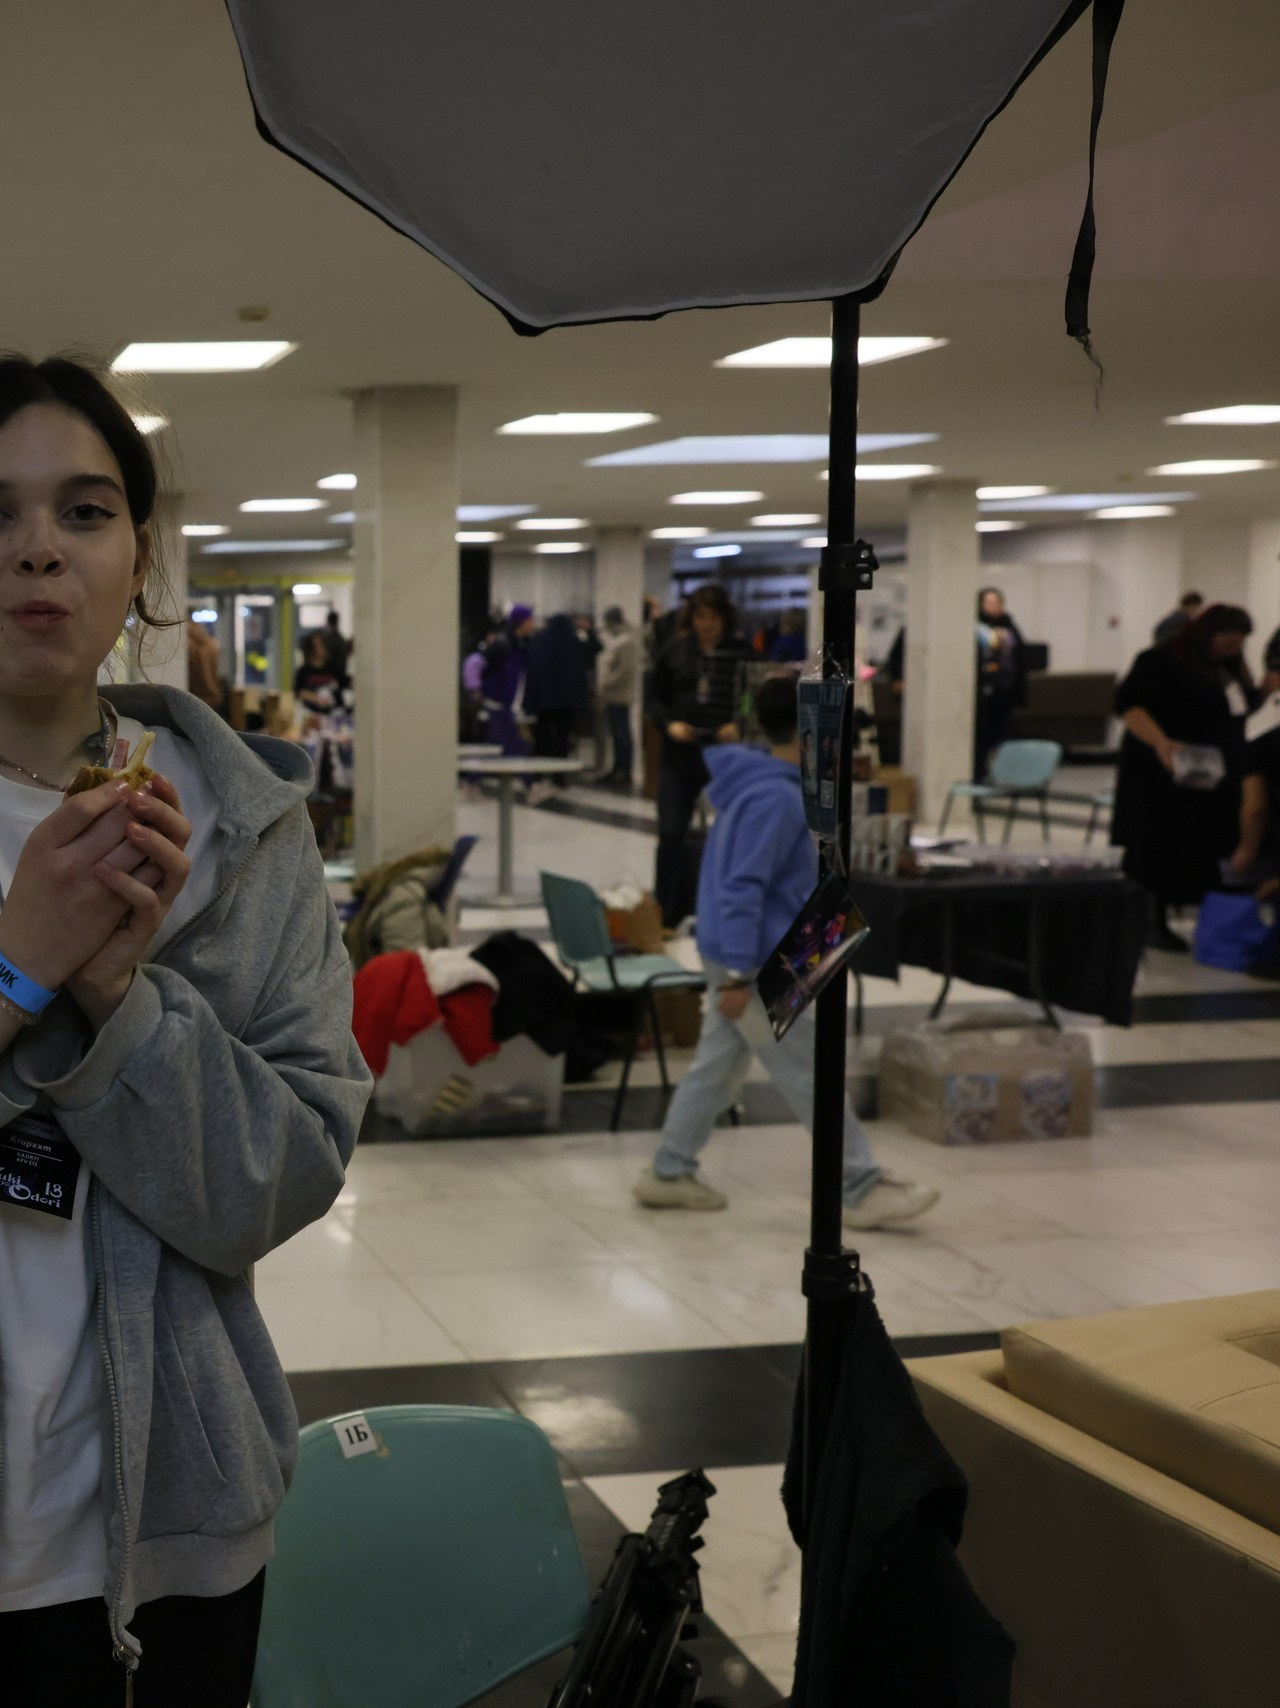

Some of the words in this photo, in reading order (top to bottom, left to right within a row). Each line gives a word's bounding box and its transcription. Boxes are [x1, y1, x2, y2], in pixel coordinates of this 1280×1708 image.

[10, 1134, 52, 1153] Krupxxm
[8, 1184, 61, 1208] Odori
[44, 1181, 63, 1198] 13
[345, 1423, 368, 1445] 1Б
